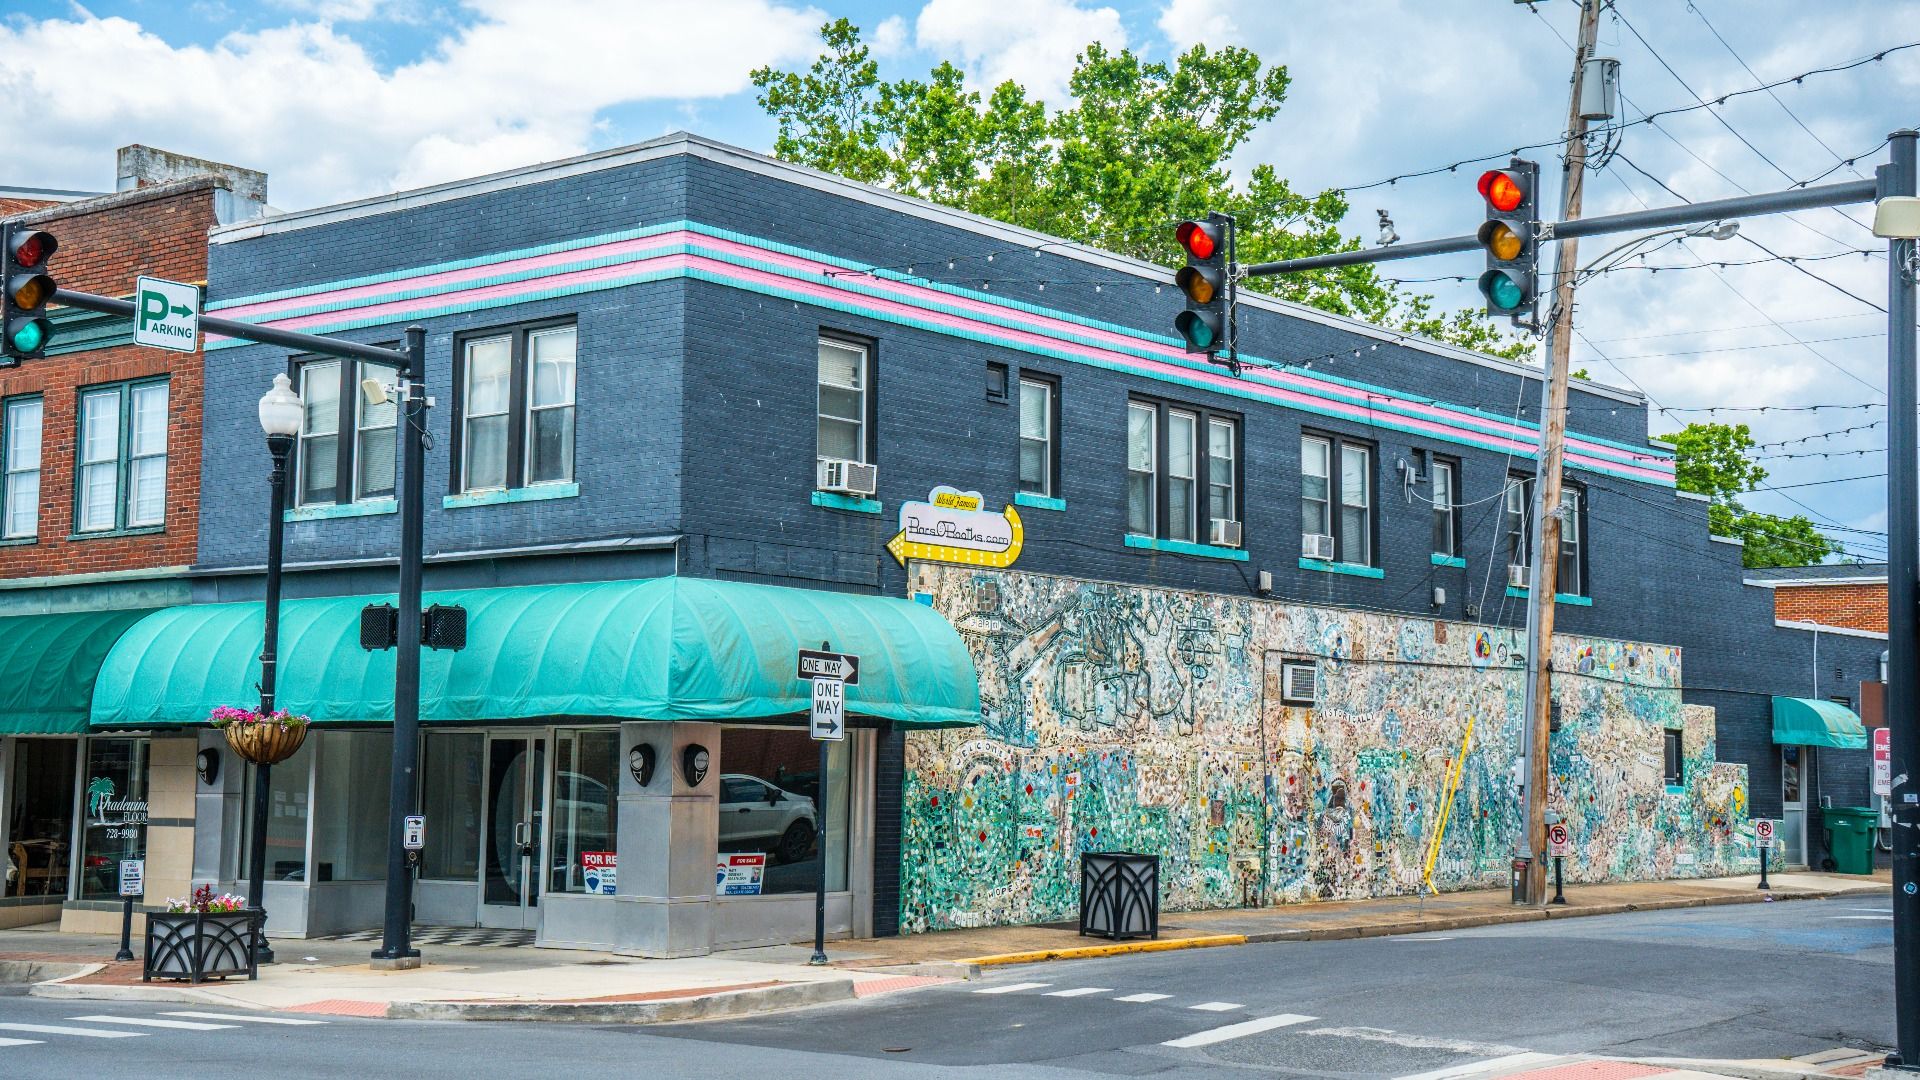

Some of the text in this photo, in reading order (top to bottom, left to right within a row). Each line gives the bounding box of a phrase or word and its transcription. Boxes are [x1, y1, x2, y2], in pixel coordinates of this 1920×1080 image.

[802, 659, 842, 674] ONE WAY
[817, 682, 840, 697] ONE
[816, 700, 840, 714] WAY
[585, 855, 617, 864] FOR RE
